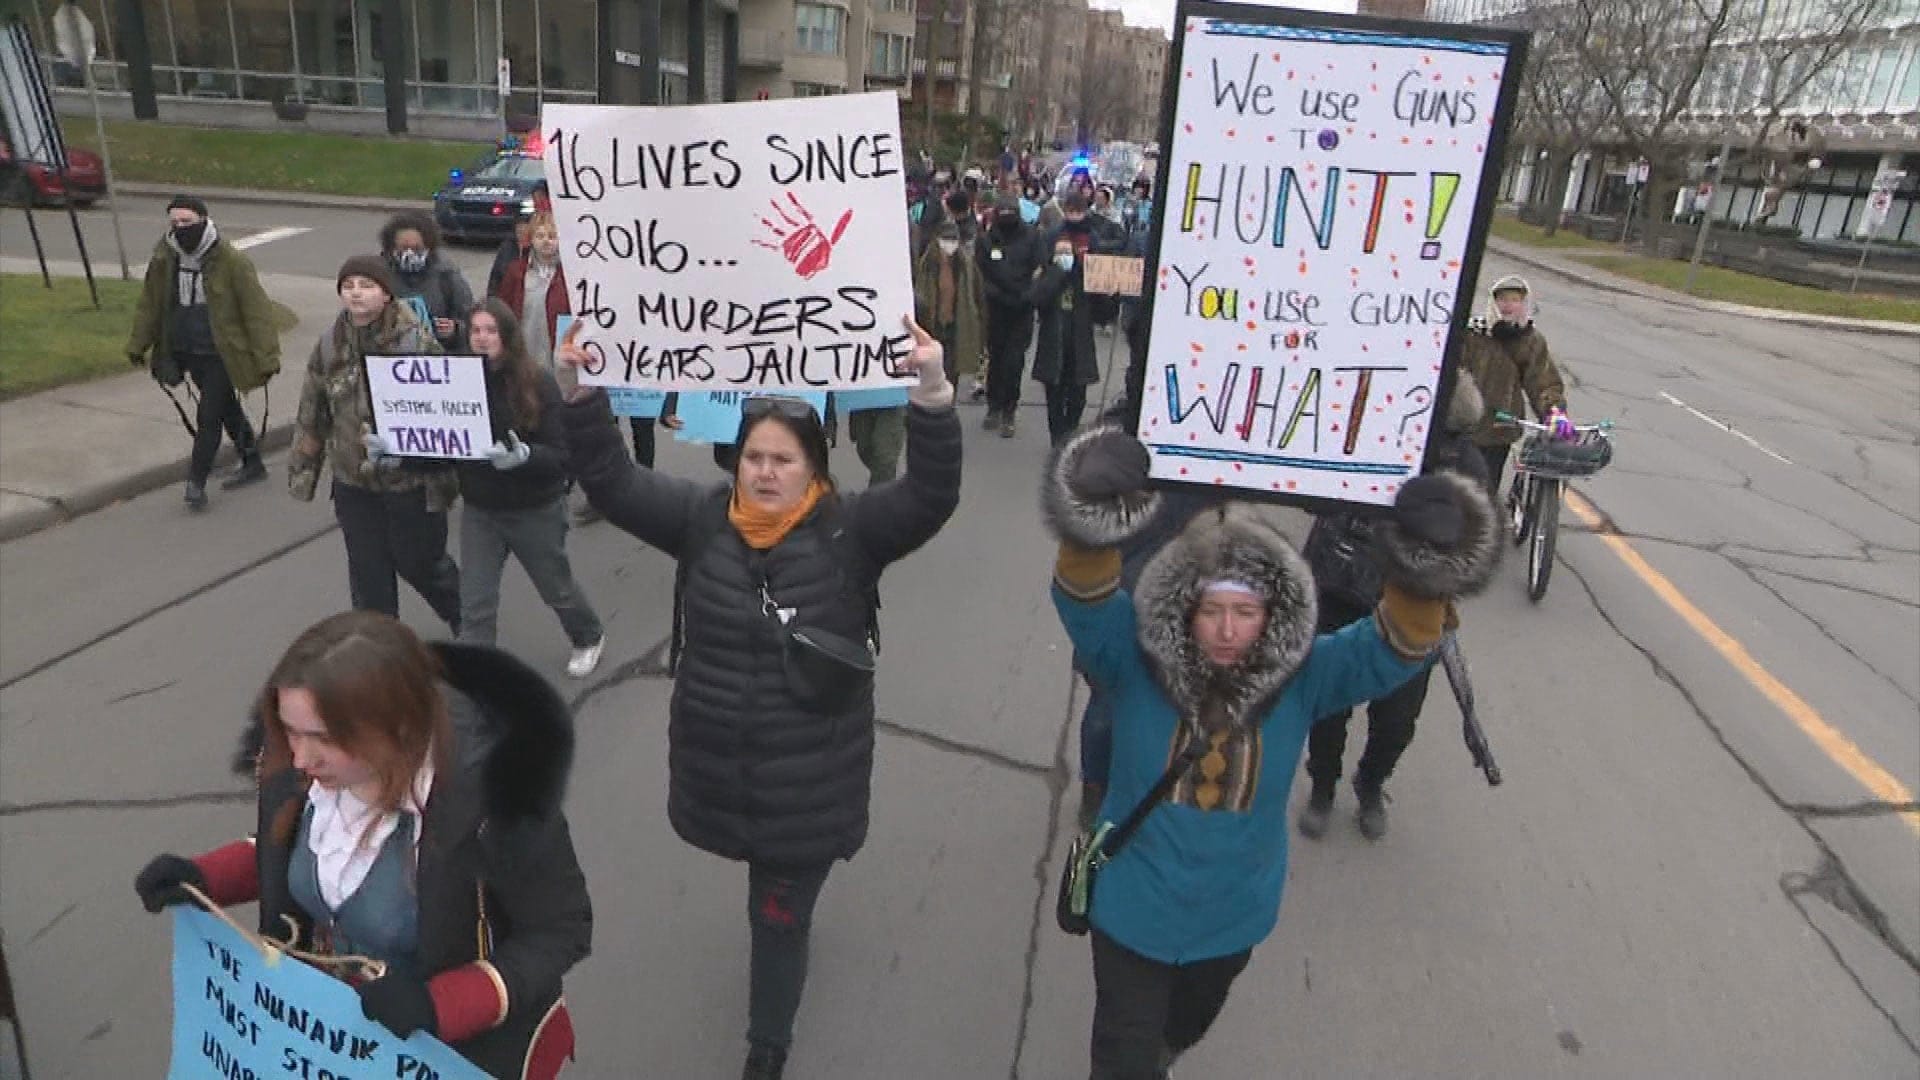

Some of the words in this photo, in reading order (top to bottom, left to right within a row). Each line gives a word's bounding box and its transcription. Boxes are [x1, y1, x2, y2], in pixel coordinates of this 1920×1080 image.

[1212, 52, 1275, 115] We
[1300, 87, 1359, 122] use
[549, 128, 605, 200] 16
[612, 138, 741, 189] LIVES
[767, 133, 898, 185] SINCE
[1290, 127, 1340, 151] TO
[1181, 161, 1461, 259] HUNT!
[576, 279, 616, 329] 16
[638, 286, 878, 336] MURDERS
[1350, 288, 1453, 326] GUNS
[617, 340, 717, 382] YEARS
[1271, 330, 1318, 350] FOR
[1164, 362, 1431, 454] WHAT?
[388, 427, 472, 456] TAIMA!
[204, 938, 243, 983] THE
[253, 981, 380, 1061] NUNAVIK
[205, 976, 261, 1046] MUST
[282, 1047, 351, 1080] STO
